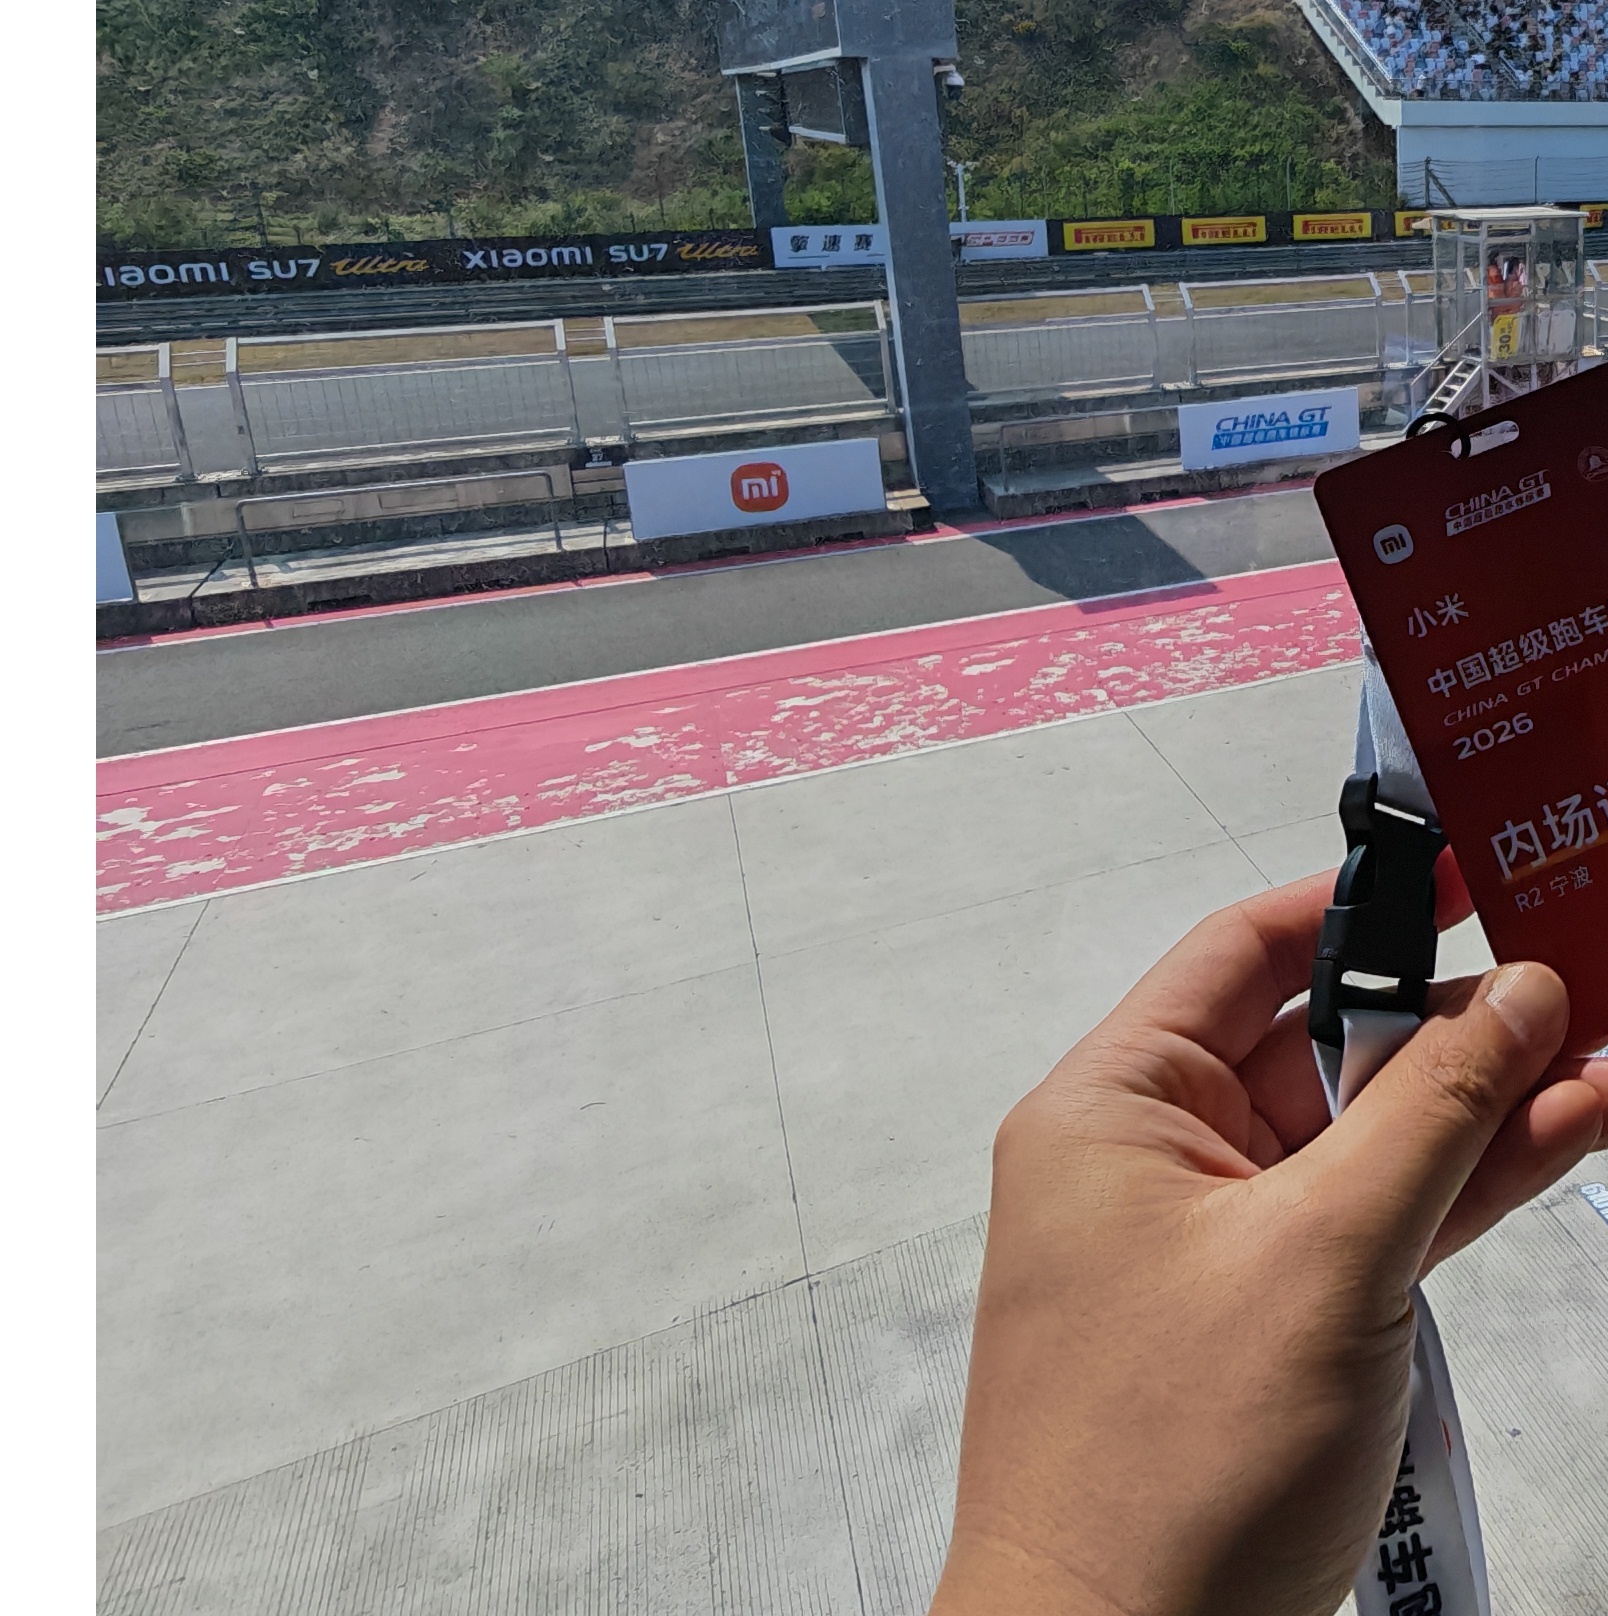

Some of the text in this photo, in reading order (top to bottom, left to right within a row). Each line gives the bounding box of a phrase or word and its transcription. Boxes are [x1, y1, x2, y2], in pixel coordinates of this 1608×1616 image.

[250, 258, 321, 281] SU7
[329, 255, 430, 276] Ultra
[609, 243, 669, 263] SU7
[676, 241, 758, 261] Ultra
[1215, 406, 1332, 433] CHINA GT
[1445, 468, 1550, 520] CHINA GT
[1406, 592, 1470, 639] 小米
[1443, 692, 1509, 728] CHINA
[1516, 675, 1545, 697] GT
[1452, 711, 1535, 761] 2026
[1513, 865, 1594, 913] R2 宁波
